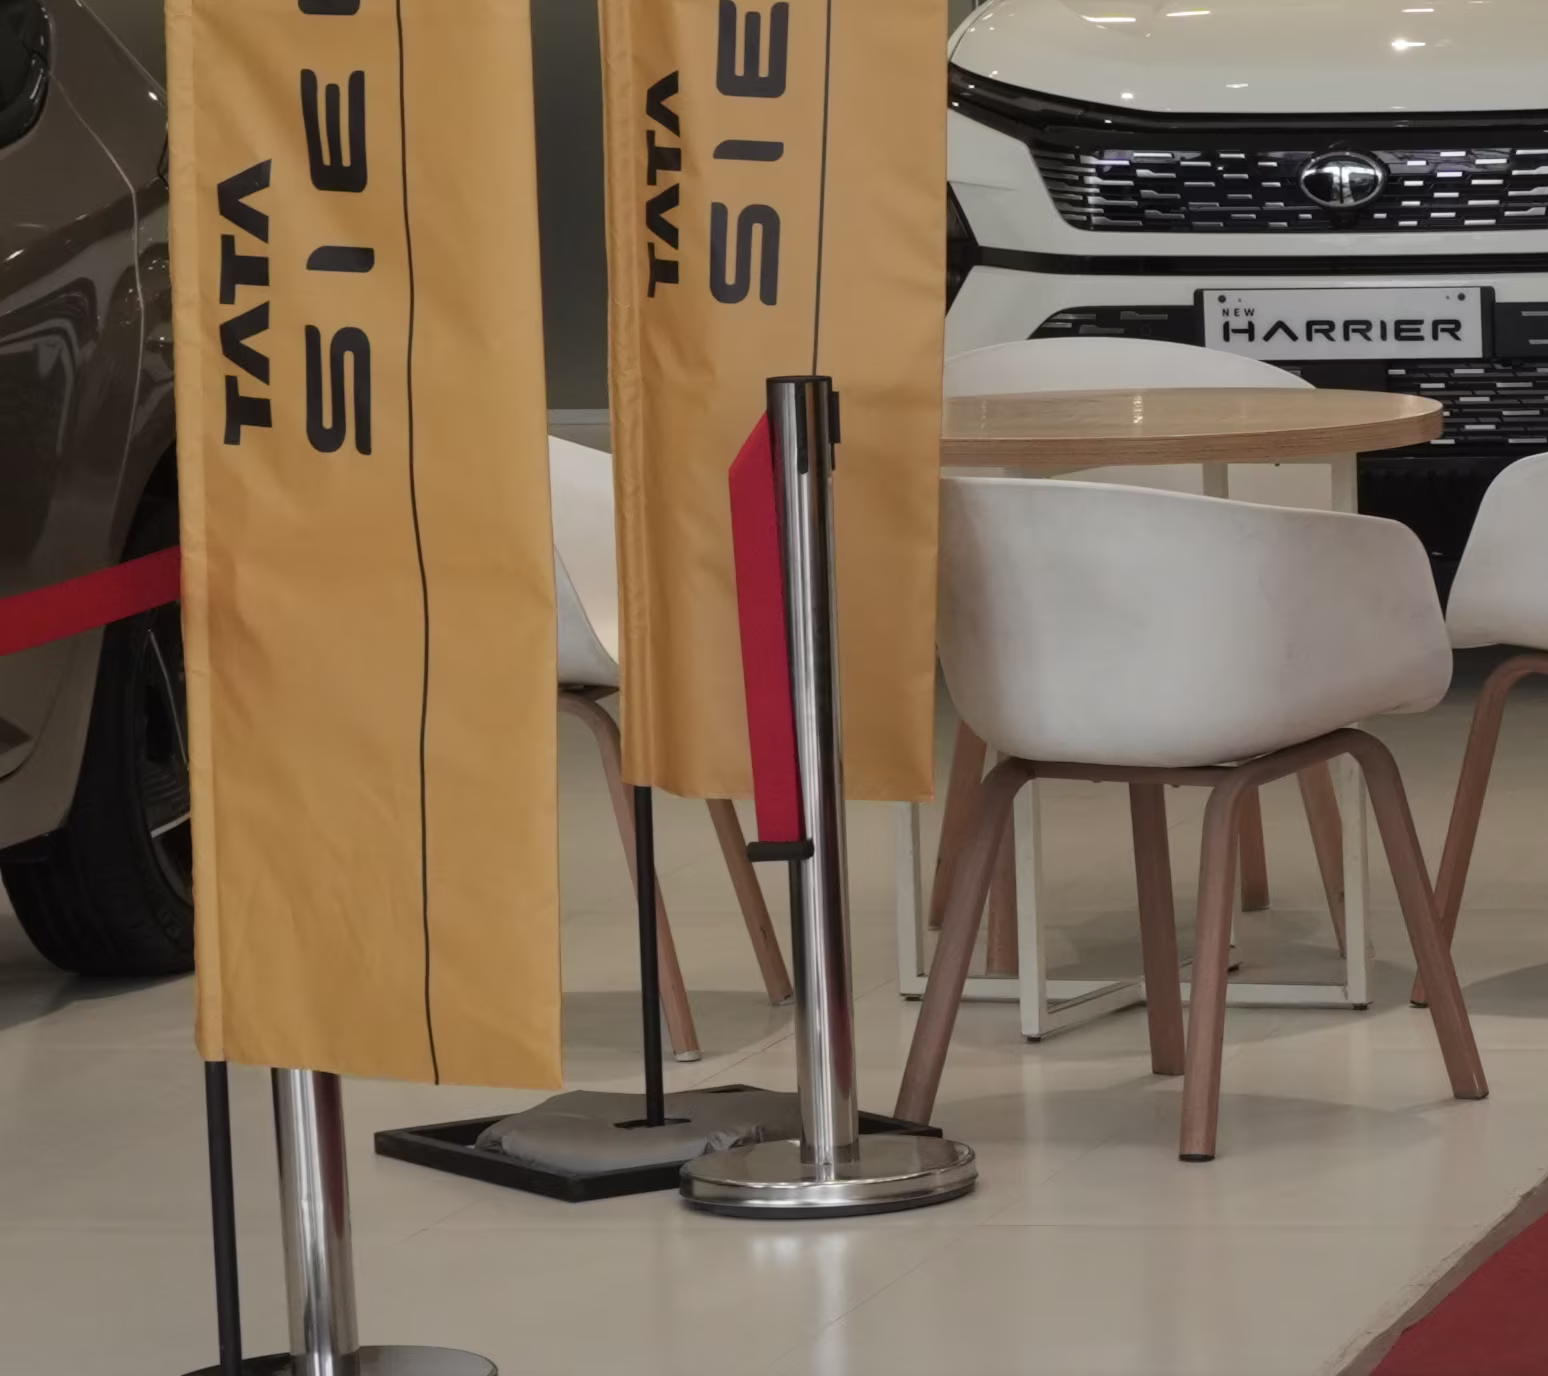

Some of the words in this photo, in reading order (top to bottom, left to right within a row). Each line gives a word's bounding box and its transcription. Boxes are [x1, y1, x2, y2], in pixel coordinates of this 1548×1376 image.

[645, 70, 683, 298] TATA
[216, 158, 273, 446] TATA
[1221, 308, 1256, 318] NEW
[1222, 319, 1463, 343] HARRIER
